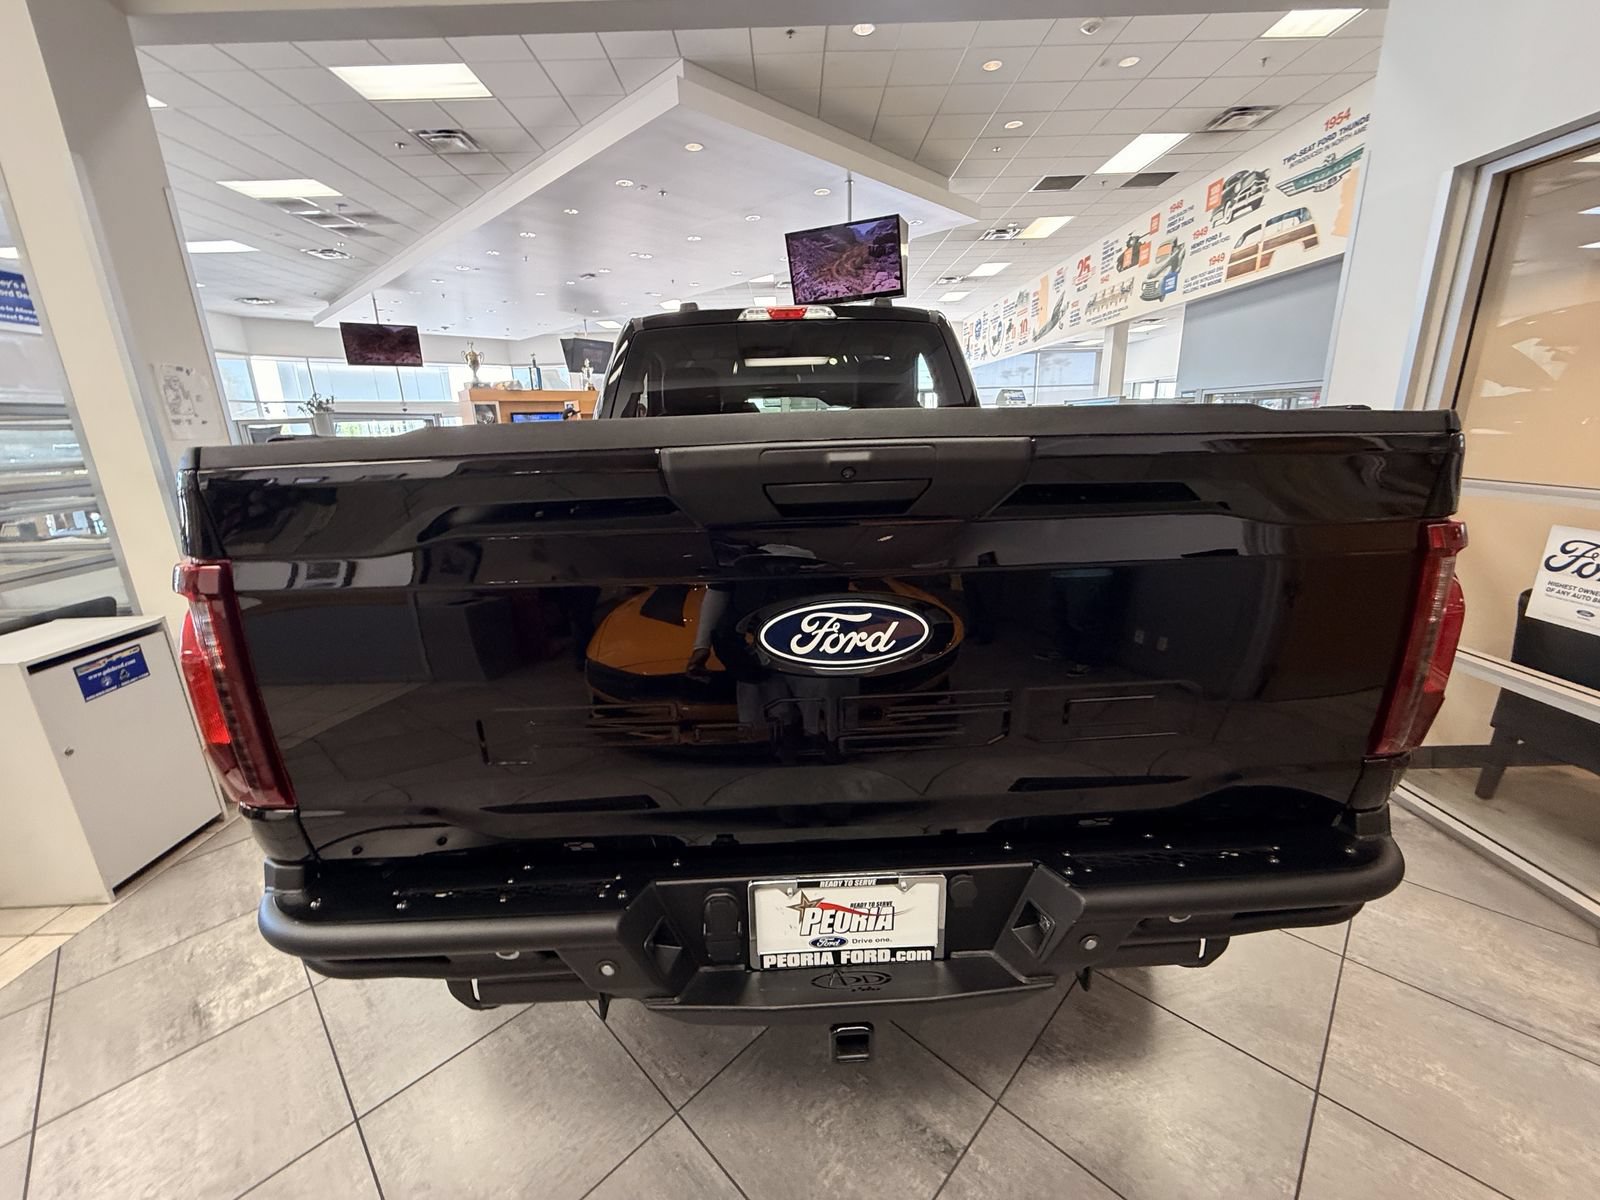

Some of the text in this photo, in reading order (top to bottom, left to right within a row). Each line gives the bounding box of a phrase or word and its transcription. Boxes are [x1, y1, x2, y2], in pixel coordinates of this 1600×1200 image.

[1325, 107, 1351, 131] 1954
[1283, 113, 1370, 165] TWO-SEAT FORD THUNDE
[1209, 252, 1225, 266] 1949
[1544, 540, 1600, 581] Fo
[1547, 580, 1600, 597] HIGHEST OWNE
[1555, 589, 1571, 597] ANY
[1571, 592, 1592, 602] AUTO
[790, 612, 899, 655] Ford
[820, 878, 877, 888] READY TO SERVE
[800, 906, 895, 936] PEORIA
[816, 937, 841, 947] Ford
[763, 949, 932, 968] PEORIA FORD.com
